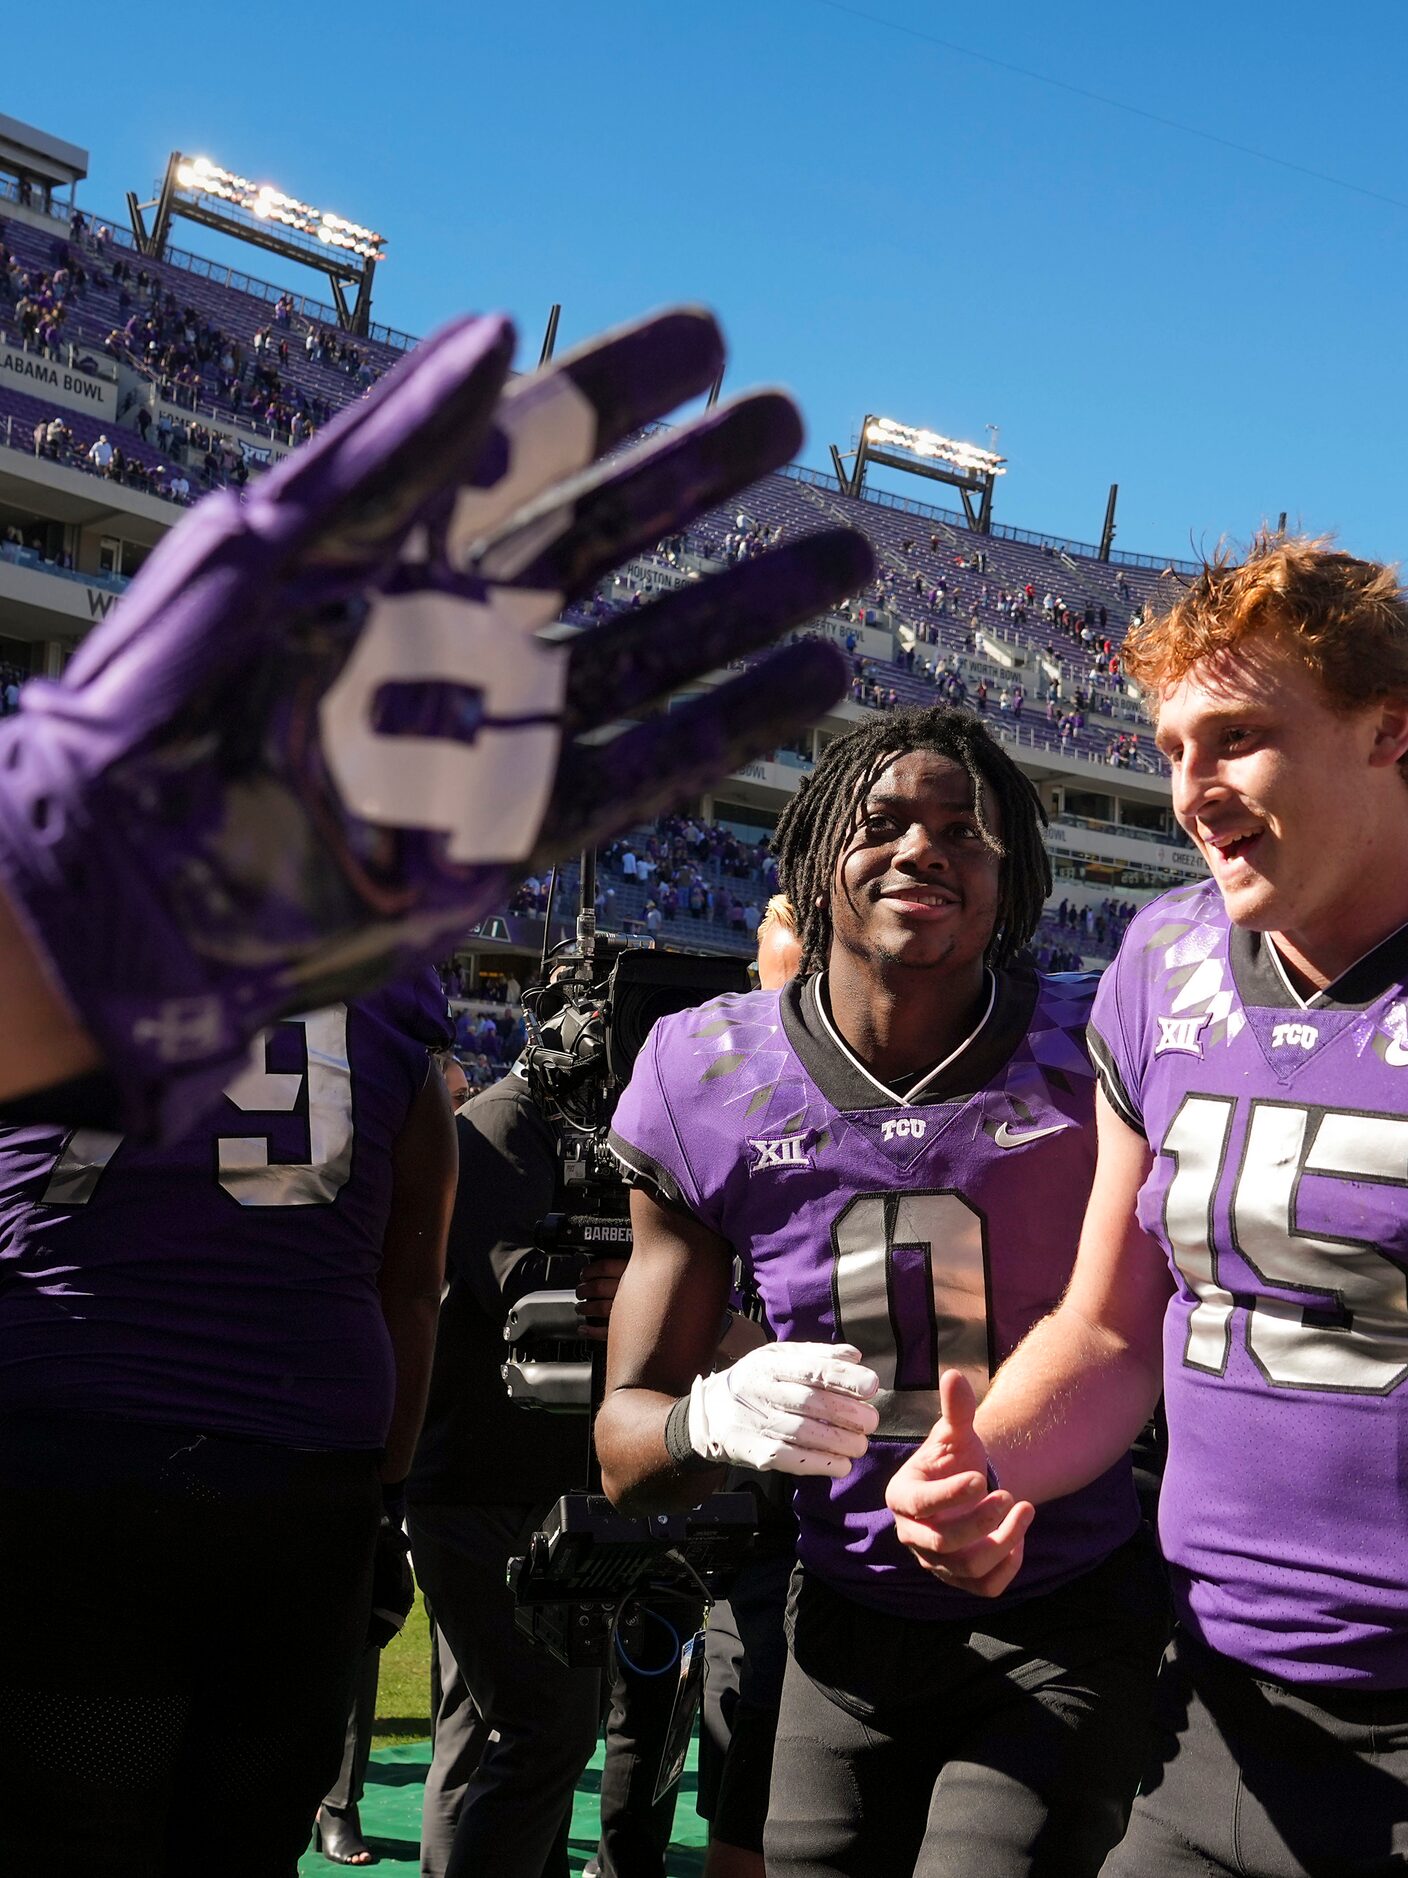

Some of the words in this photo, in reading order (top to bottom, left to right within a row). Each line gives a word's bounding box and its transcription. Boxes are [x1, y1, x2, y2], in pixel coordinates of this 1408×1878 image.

[63, 374, 104, 402] BOWL
[628, 564, 672, 587] HOUSTON
[970, 661, 998, 676] WORTH
[1000, 668, 1023, 684] BOWL
[1154, 1014, 1210, 1055] XII
[1271, 1023, 1318, 1050] TCU
[881, 1118, 926, 1142] TCU
[749, 1132, 812, 1172] XII
[584, 1226, 634, 1242] BARBER
